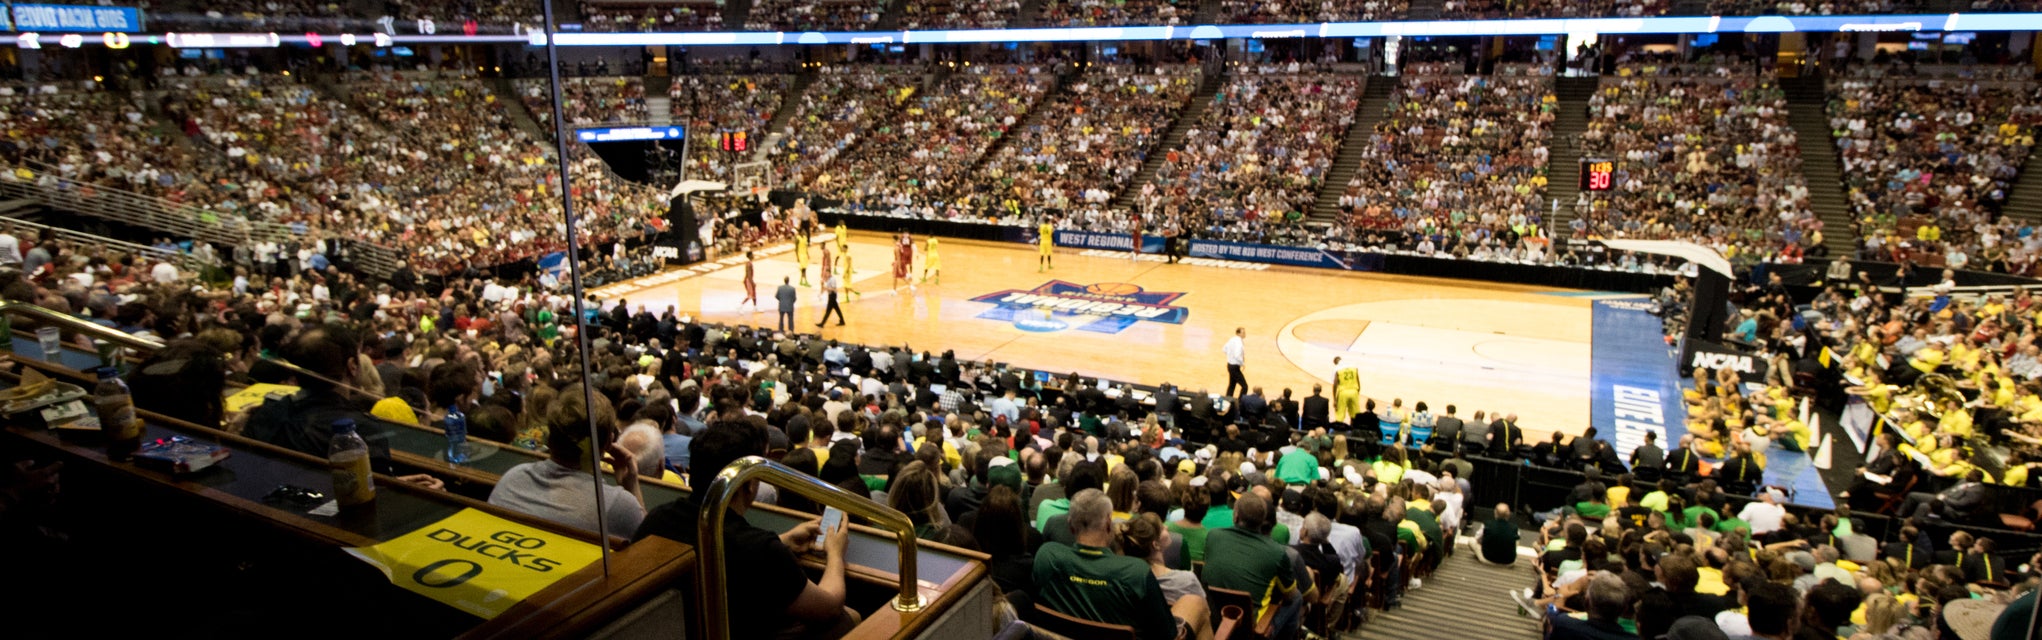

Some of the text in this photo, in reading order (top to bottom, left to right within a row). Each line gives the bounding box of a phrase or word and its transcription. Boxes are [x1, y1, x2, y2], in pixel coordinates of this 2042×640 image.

[1590, 172, 1610, 189] 30
[1060, 232, 1134, 249] WEST REGIONAL
[1192, 243, 1324, 263] HOSTED BY THE BIG WEST CONFERENCE
[1000, 292, 1169, 317] REGIONAL
[1692, 351, 1754, 373] NCAA
[426, 528, 562, 572] DUCKS
[490, 531, 546, 550] GO
